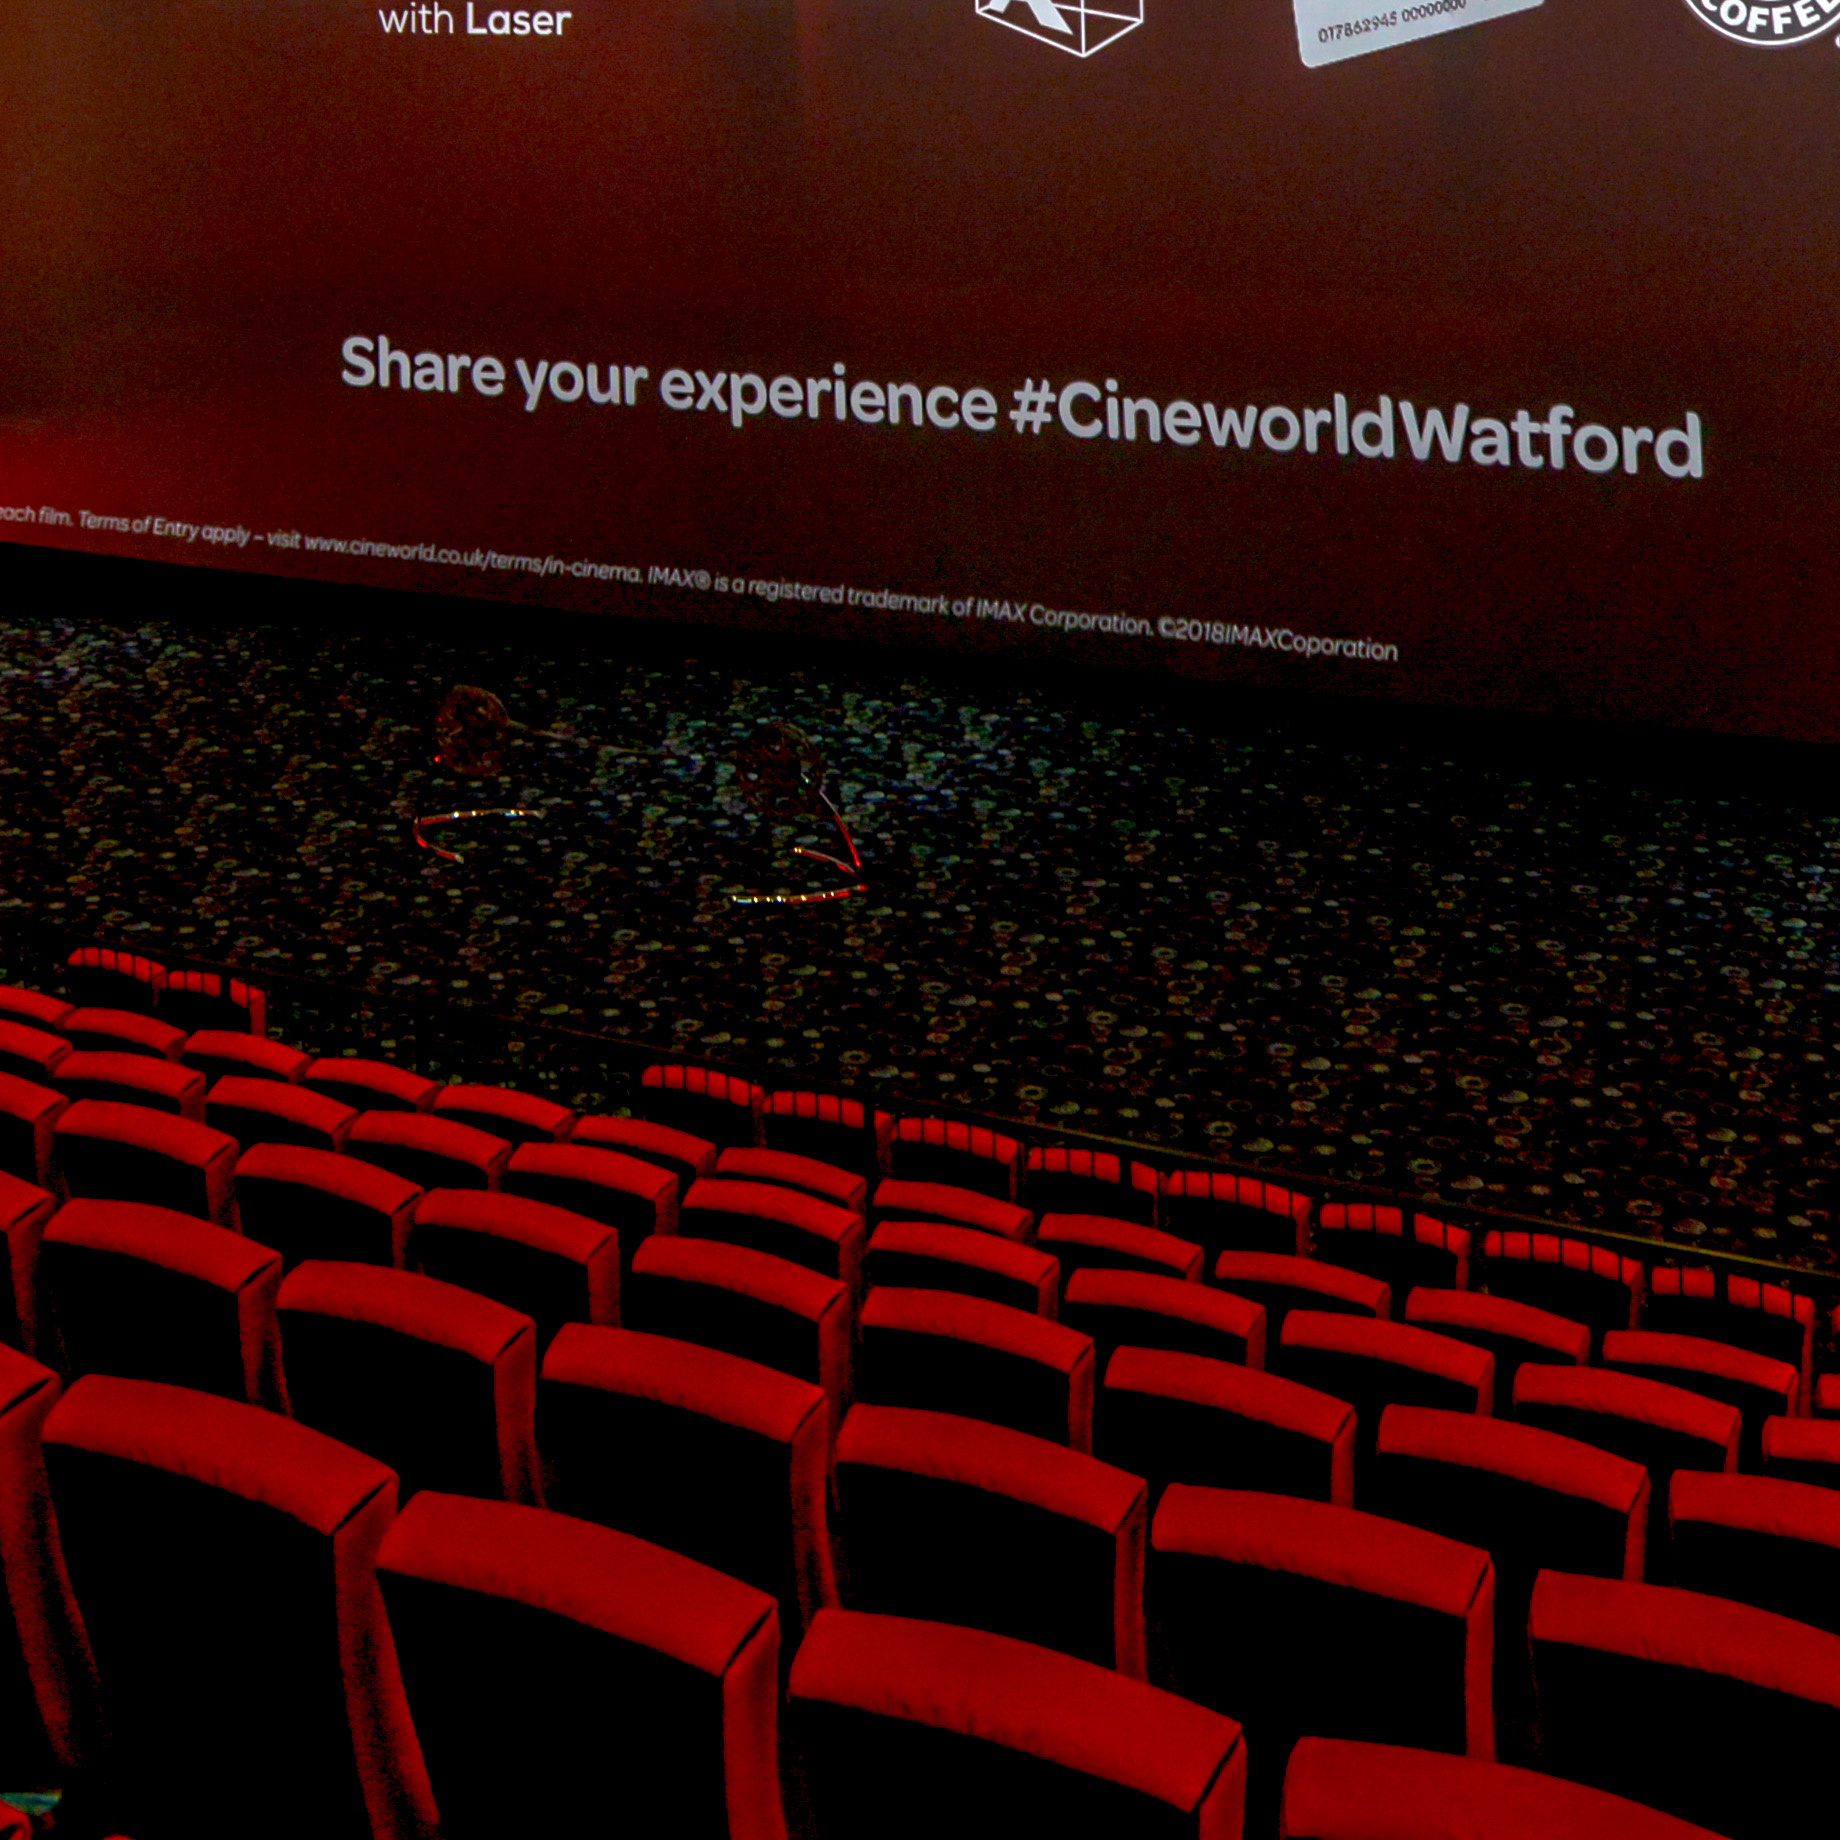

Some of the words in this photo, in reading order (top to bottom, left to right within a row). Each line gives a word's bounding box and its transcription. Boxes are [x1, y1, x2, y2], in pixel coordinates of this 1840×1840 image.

[378, 1, 454, 35] with
[466, 1, 572, 36] Laser
[342, 335, 506, 396] Share
[515, 359, 649, 412] your
[660, 362, 998, 431] experience
[1009, 377, 1703, 479] #CineworldWatford
[38, 506, 75, 527] film.
[78, 509, 130, 533] Terms
[131, 515, 153, 534] of
[152, 515, 201, 543] Entry
[201, 524, 251, 548] apply
[267, 530, 302, 550] visit
[714, 572, 729, 593] is
[731, 577, 745, 594] a
[748, 579, 846, 610] registered
[847, 587, 949, 615] trademark
[951, 597, 975, 617] of
[975, 598, 1028, 623] IMAX
[1029, 603, 1154, 637] Corporation.
